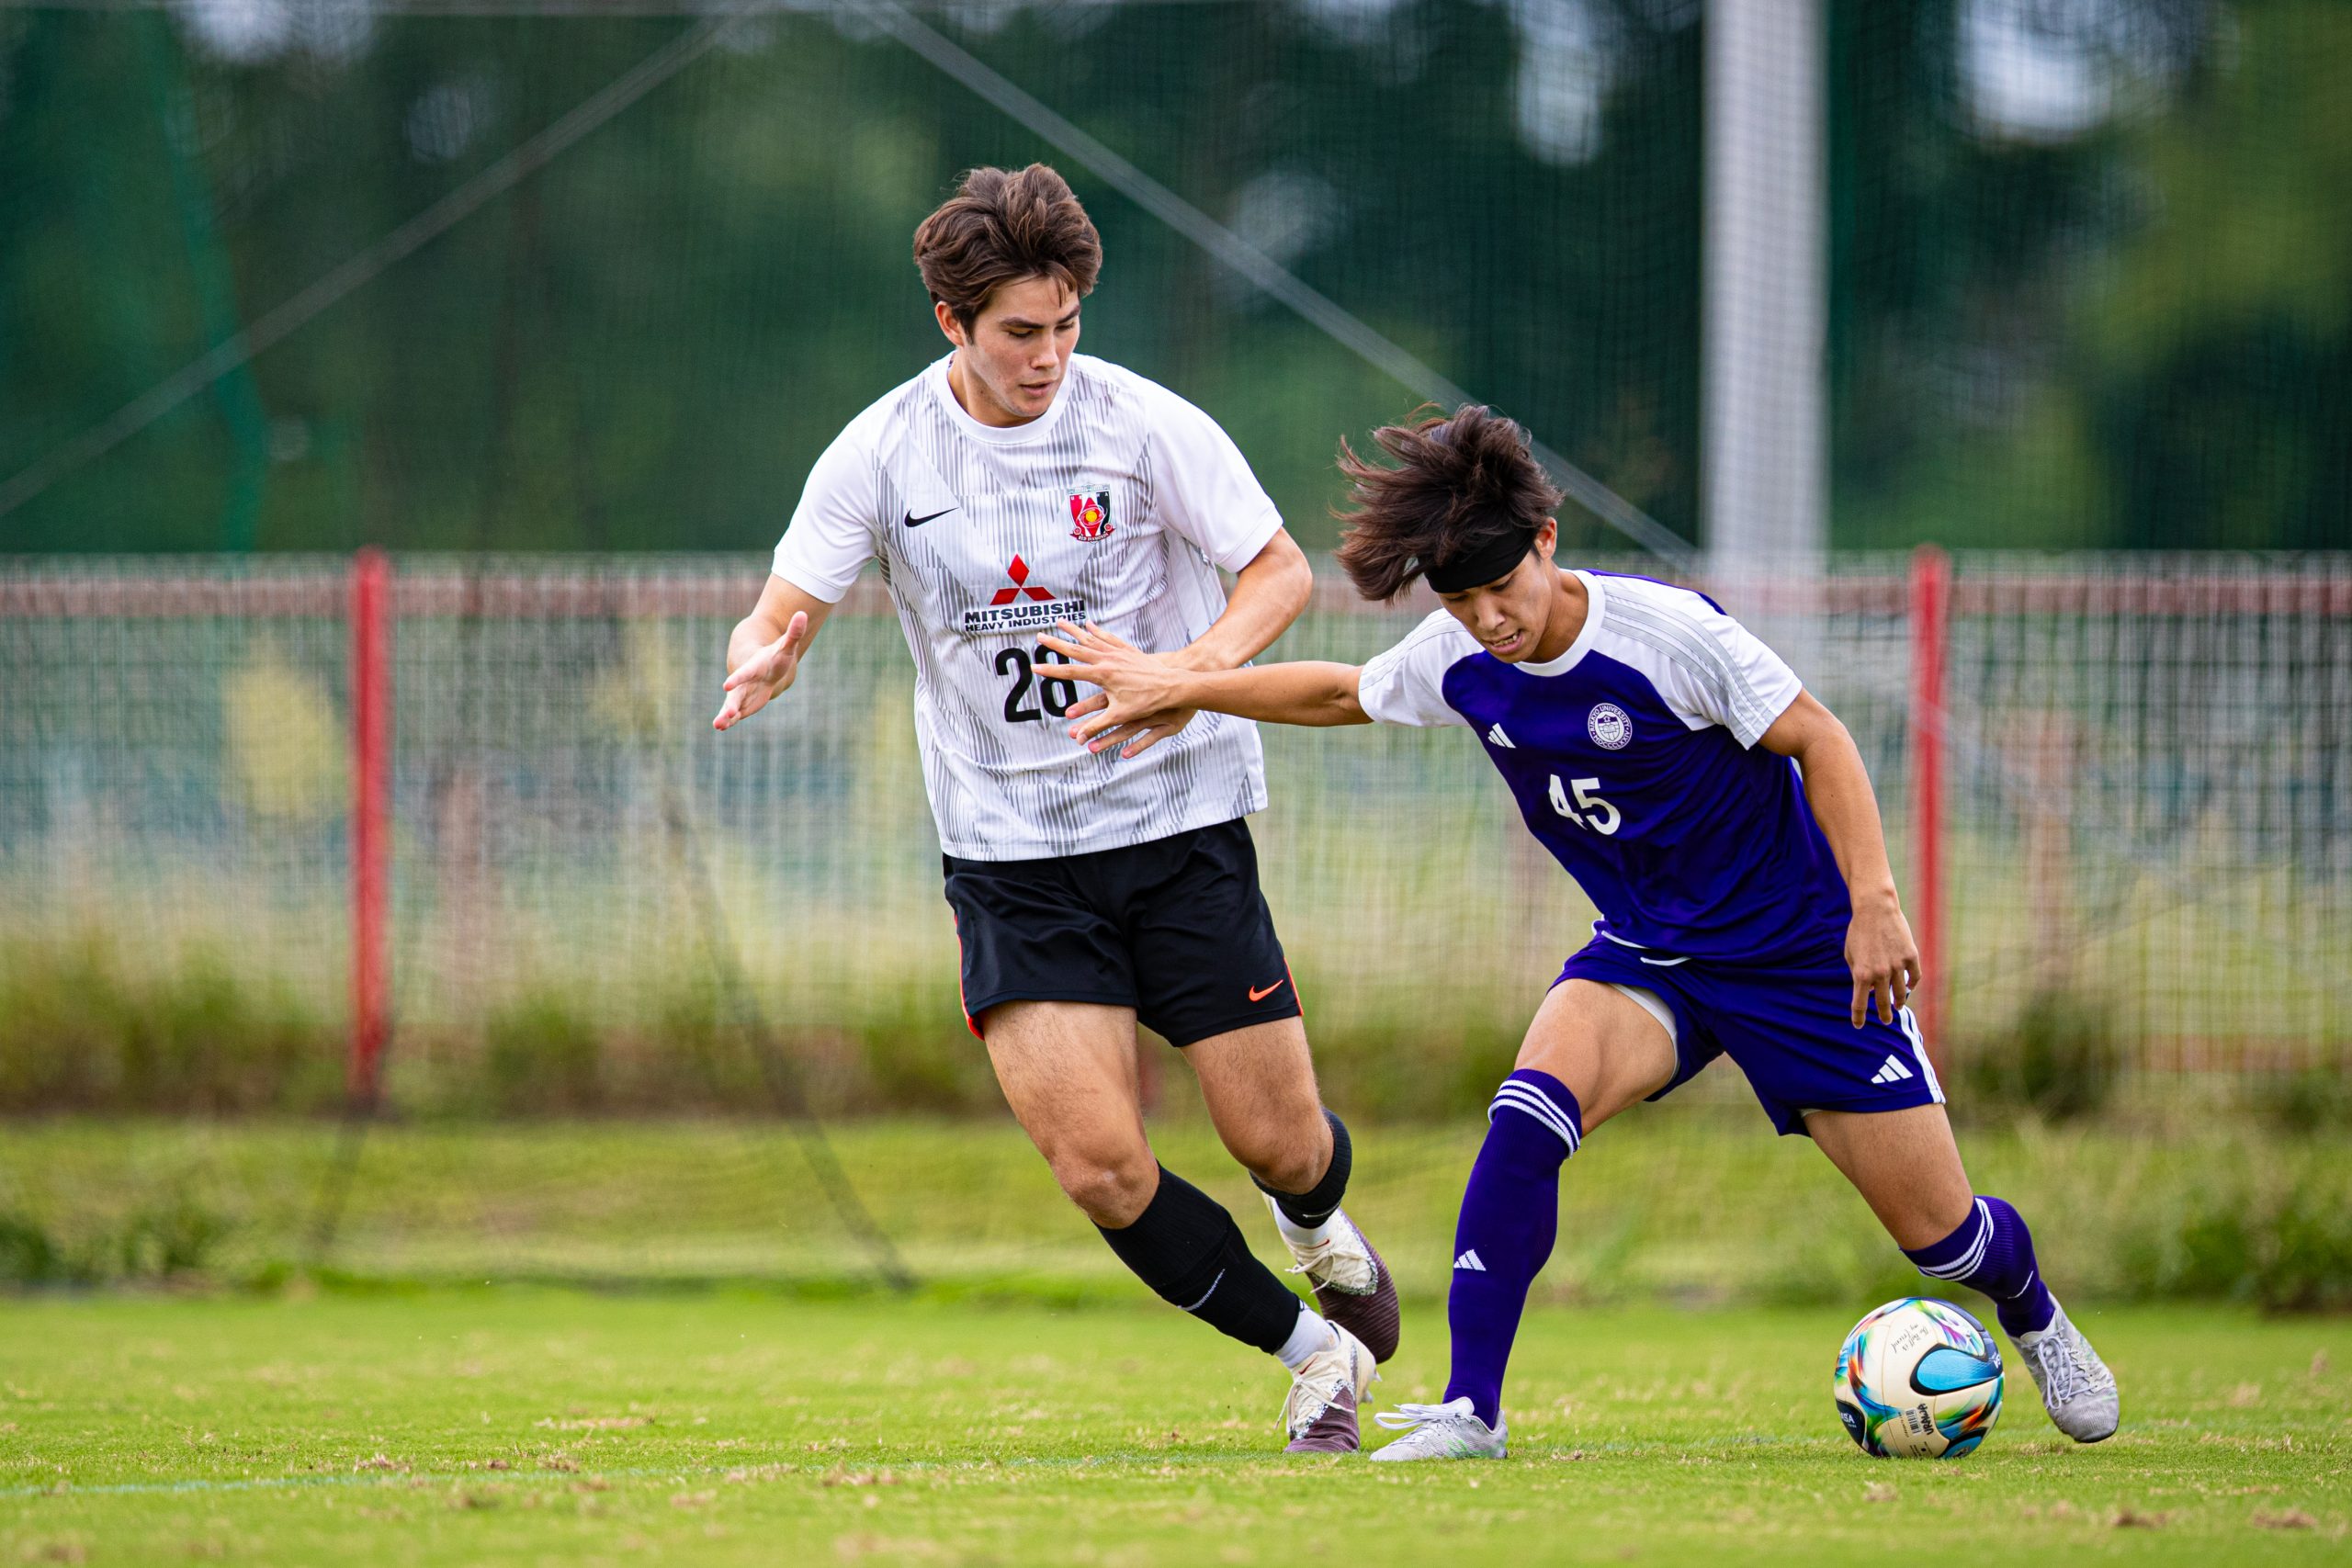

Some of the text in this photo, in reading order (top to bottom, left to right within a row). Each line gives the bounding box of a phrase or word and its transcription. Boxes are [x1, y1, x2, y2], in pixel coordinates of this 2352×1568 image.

[965, 600, 1085, 623] MITSUBISHI
[966, 621, 1004, 632] HEAVY
[995, 644, 1079, 723] 28
[1589, 705, 1630, 732] RIKKYO UNIVERSITY
[1548, 773, 1621, 835] 45
[1917, 1403, 1934, 1435] URAWA
